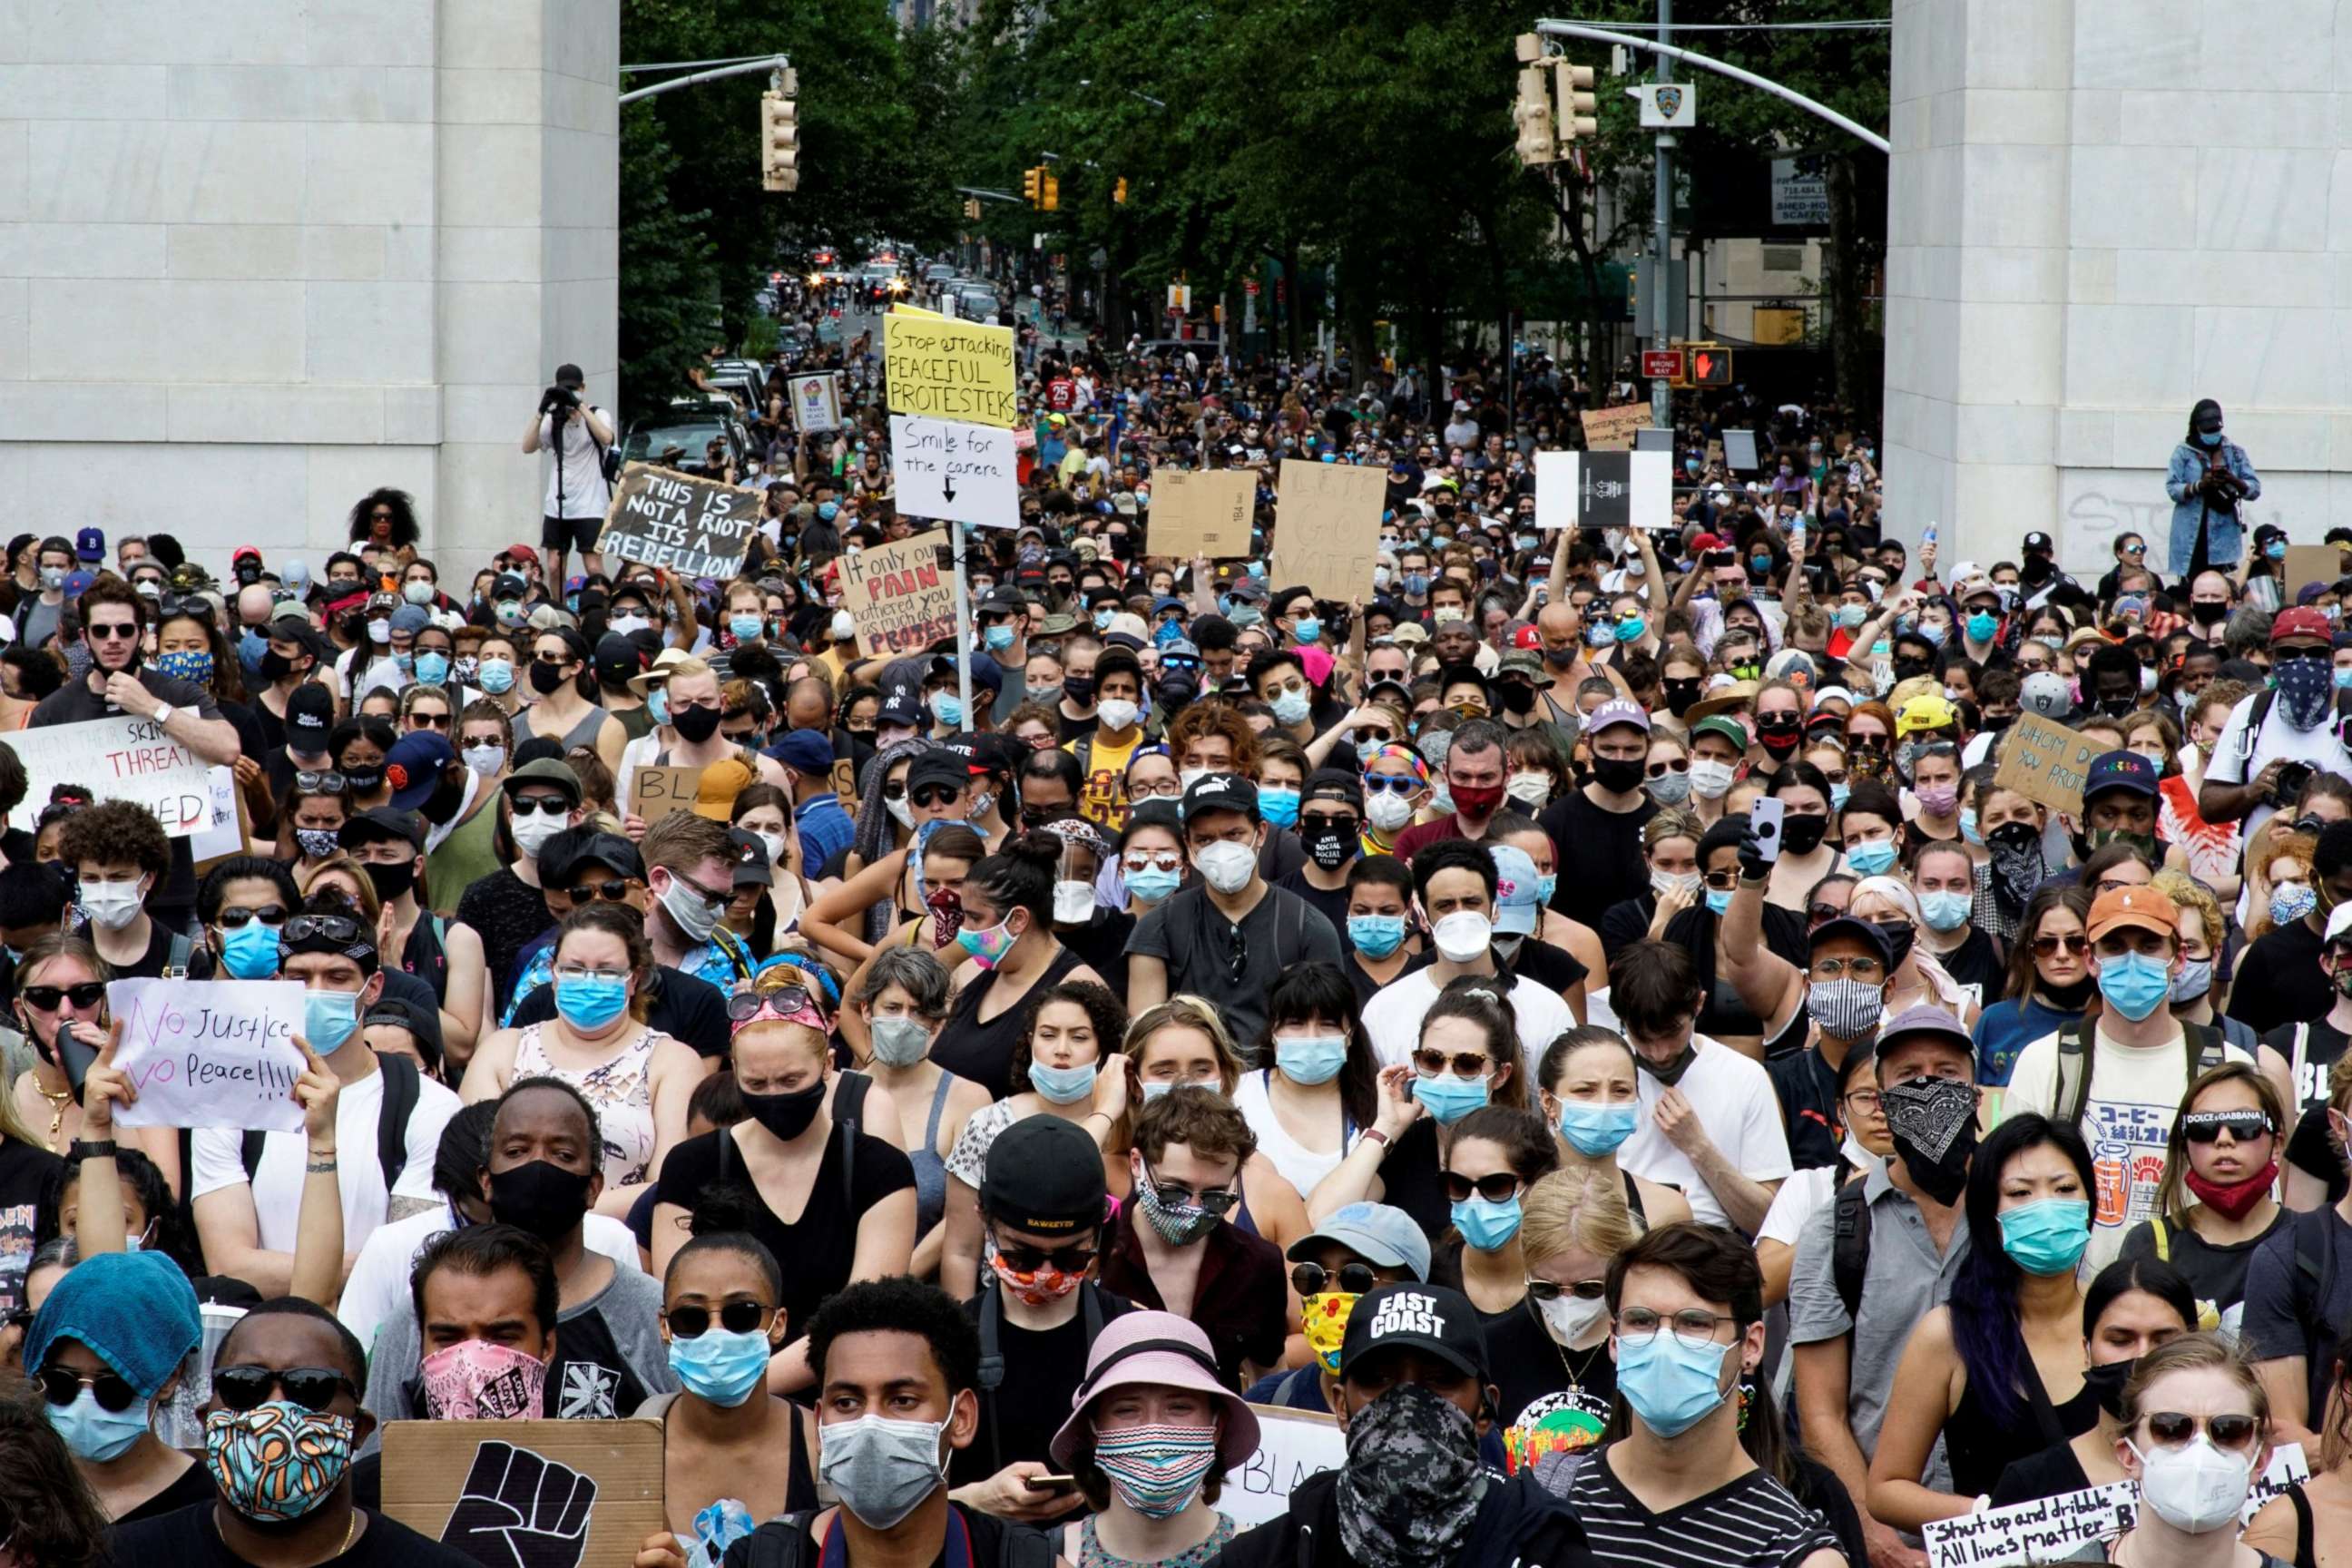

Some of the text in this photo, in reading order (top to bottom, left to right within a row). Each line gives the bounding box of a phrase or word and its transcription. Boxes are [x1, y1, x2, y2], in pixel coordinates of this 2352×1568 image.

[890, 321, 936, 352] Stop
[888, 355, 991, 385] PEACEFUL
[890, 381, 1016, 423] PROTESTERS
[1053, 386, 1069, 401] 25
[904, 421, 958, 452] Smile
[965, 430, 995, 454] for
[904, 457, 936, 473] the
[642, 474, 732, 514] THIS IS
[626, 495, 752, 540] NOT A RIOT
[643, 520, 710, 554] ITS A
[603, 530, 743, 578] REBELLION
[844, 554, 864, 585] If
[870, 547, 906, 575] only
[867, 562, 940, 602] PAIN
[851, 587, 951, 624] bothered you
[862, 622, 879, 636] as
[880, 612, 916, 634] much
[917, 608, 933, 622] as
[1601, 700, 1637, 716] NYU
[127, 720, 168, 744] SKIN
[2017, 721, 2068, 755] WHOM
[105, 746, 197, 779] THREAT
[1195, 781, 1226, 797] PUMA
[1315, 843, 1341, 851] SOCIAL
[1315, 850, 1341, 858] SOCIAL
[1320, 835, 1338, 844] ANTI
[1318, 858, 1338, 866] CLUB
[192, 1005, 291, 1049] Justice
[2187, 1112, 2215, 1123] DOLCE
[2219, 1110, 2261, 1122] GABBANA
[1377, 1291, 1438, 1316] EAST
[1370, 1309, 1446, 1339] COAST
[1989, 1514, 2013, 1536] up
[2014, 1499, 2048, 1527] and
[1971, 1537, 2020, 1563] lives
